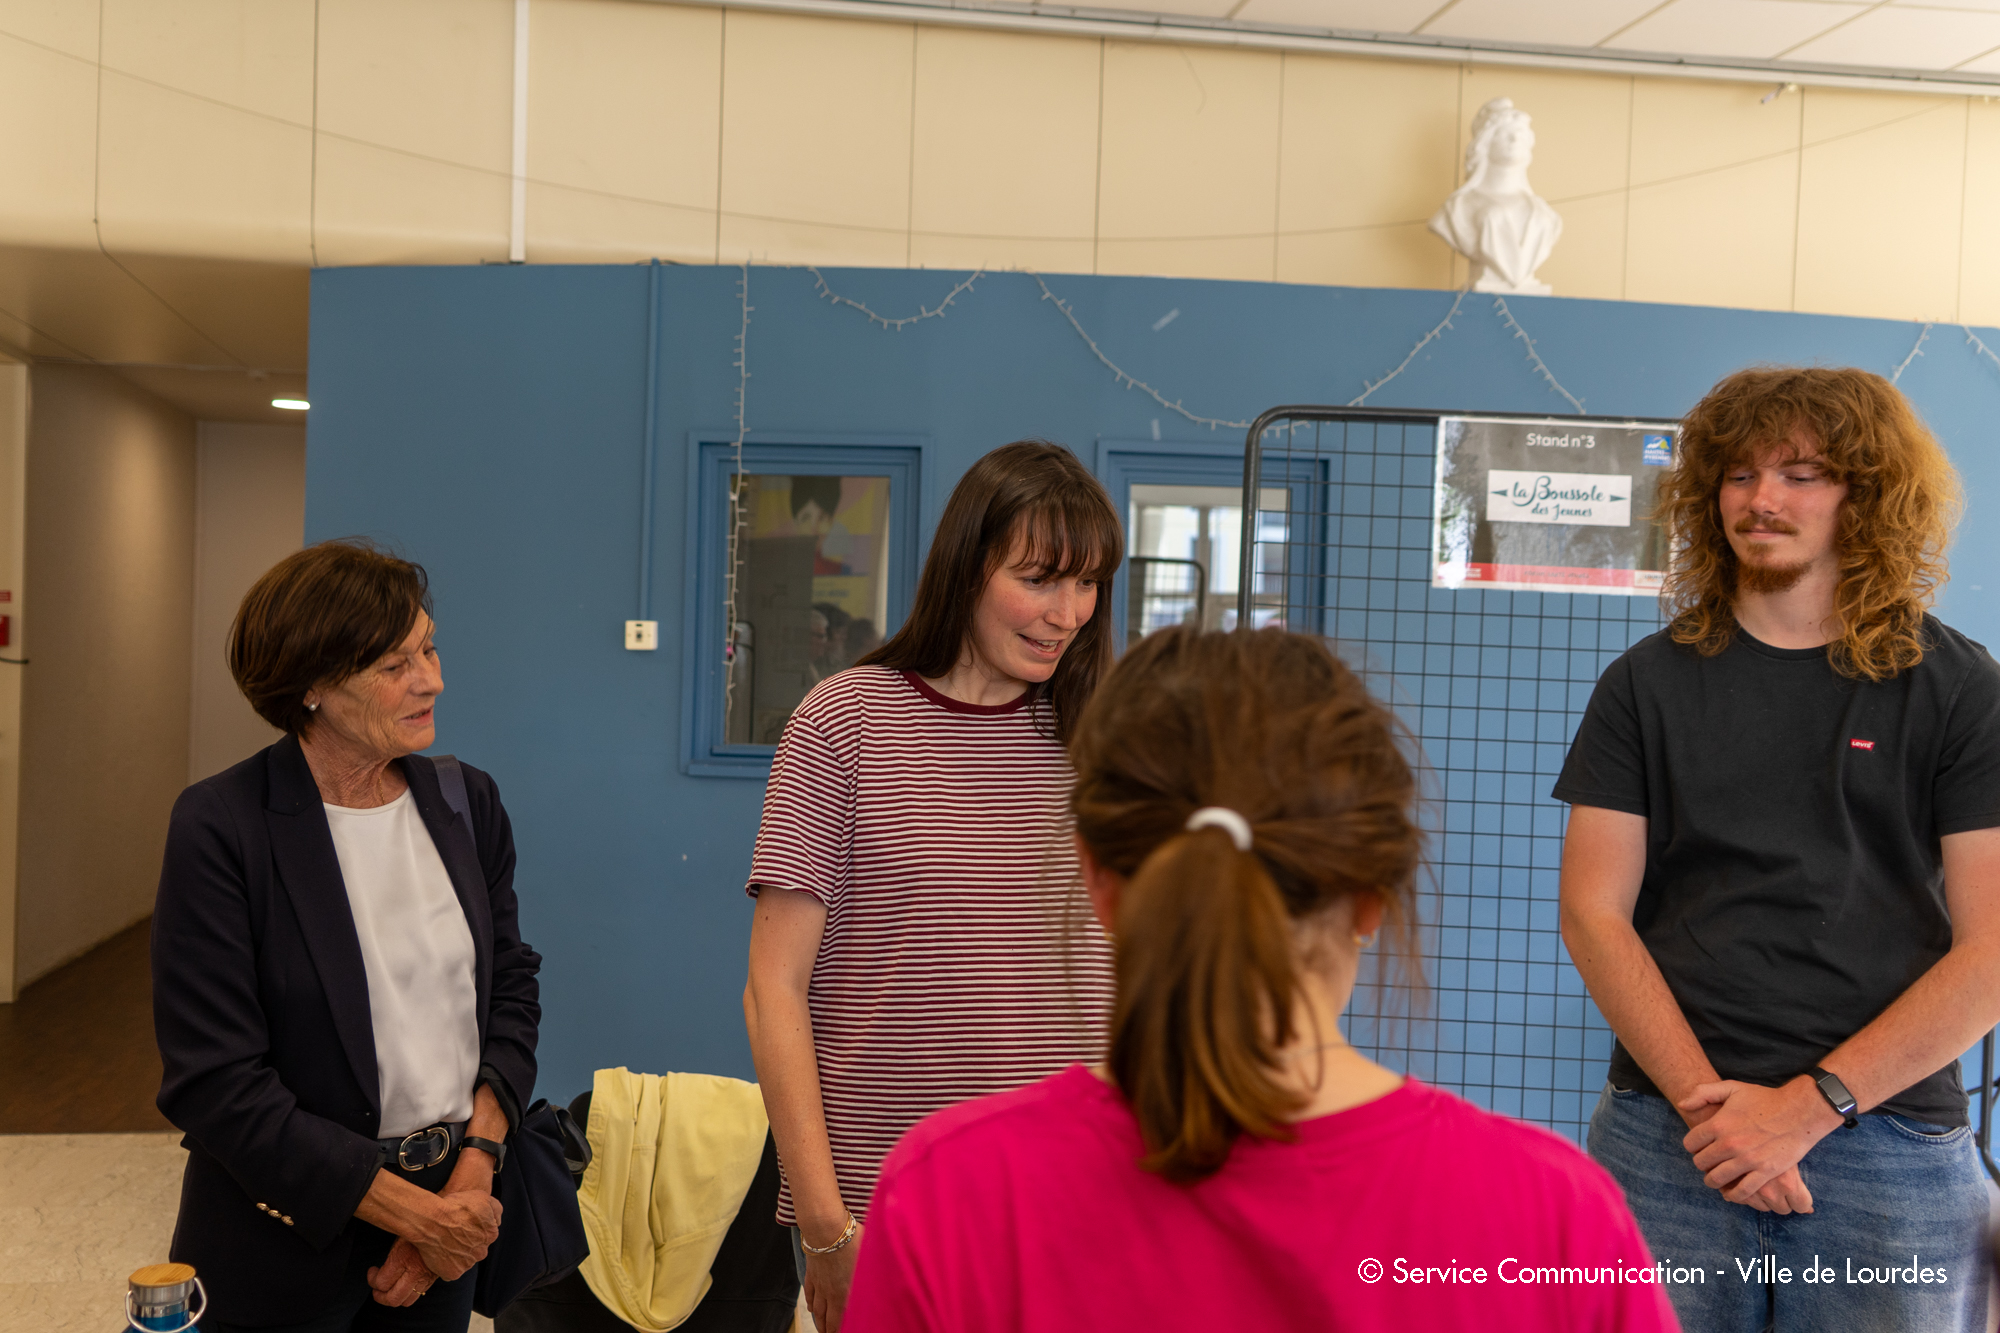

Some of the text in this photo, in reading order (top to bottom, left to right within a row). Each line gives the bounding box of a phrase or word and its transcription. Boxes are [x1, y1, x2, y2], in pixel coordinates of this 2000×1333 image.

[1526, 432, 1569, 447] Stand
[1511, 475, 1605, 507] la Boussole
[1531, 502, 1592, 520] des Jeunes
